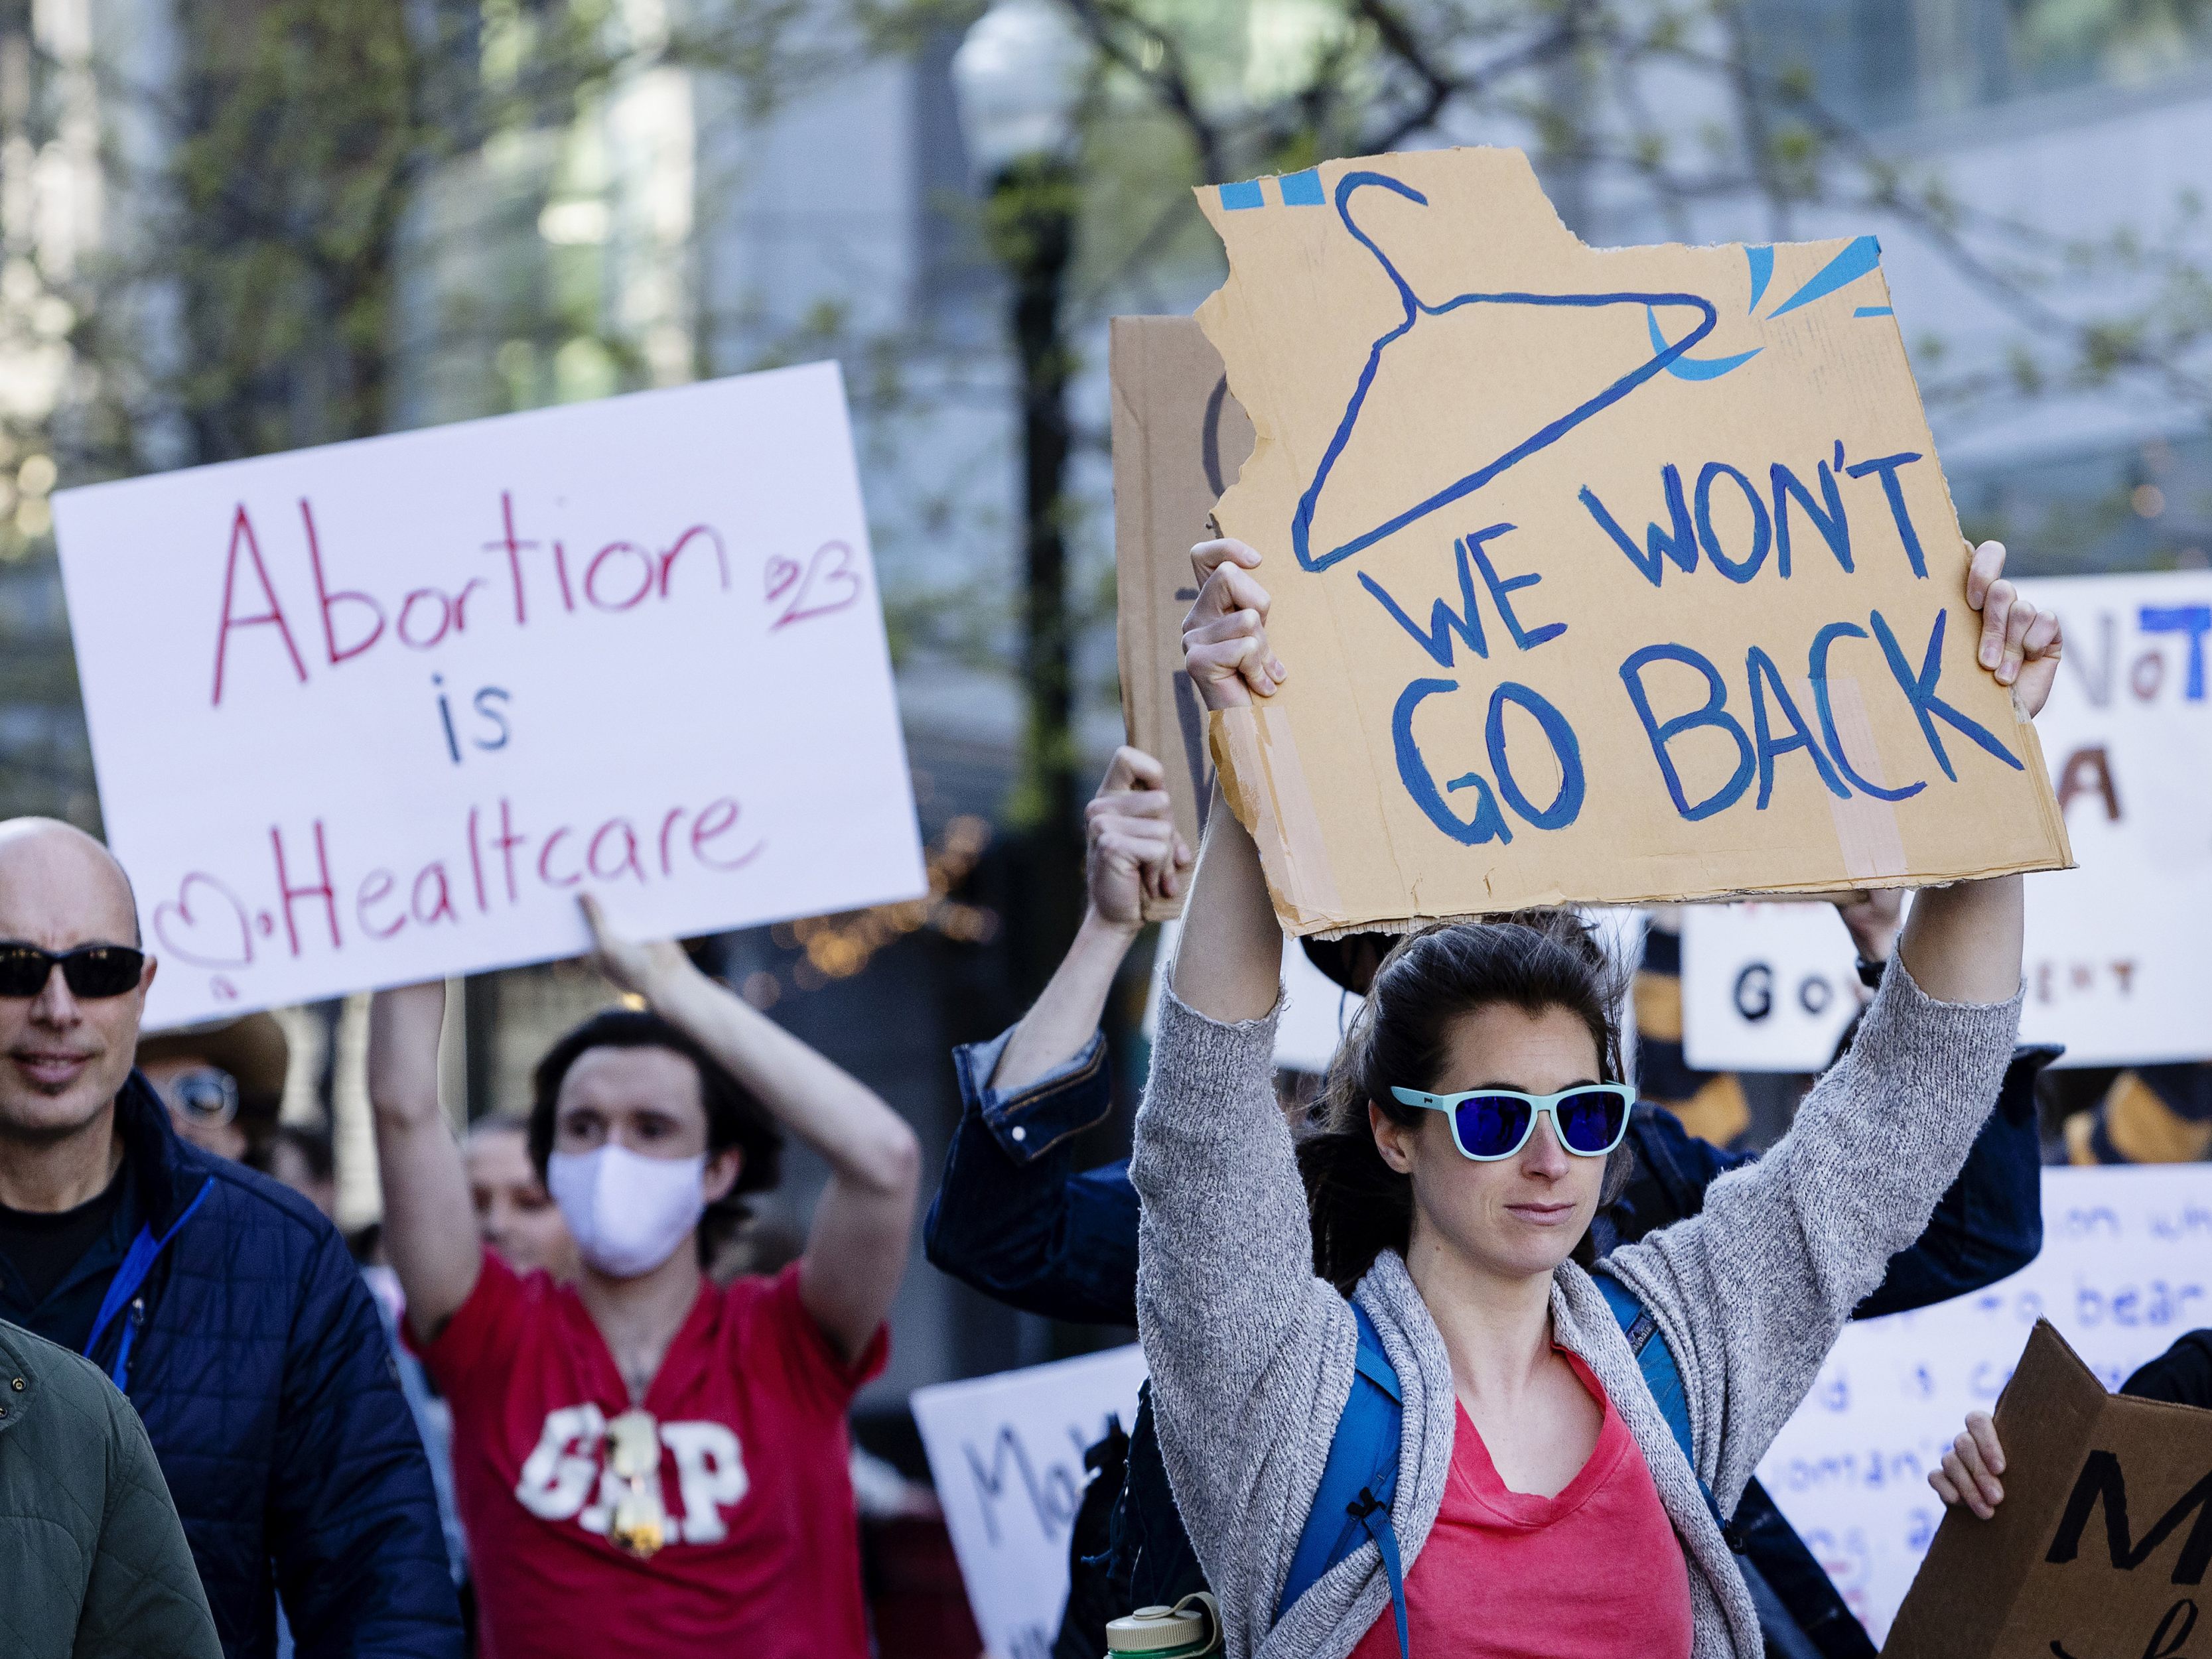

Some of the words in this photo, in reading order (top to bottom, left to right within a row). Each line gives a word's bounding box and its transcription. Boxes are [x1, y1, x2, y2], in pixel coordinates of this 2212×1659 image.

[210, 490, 732, 707] Abortion
[1357, 522, 1568, 668] WE
[1578, 438, 1929, 588] WON'T
[431, 673, 512, 765] is
[1391, 677, 1588, 846] GO
[1619, 608, 2025, 822] BACK
[271, 796, 766, 957] Healtcare
